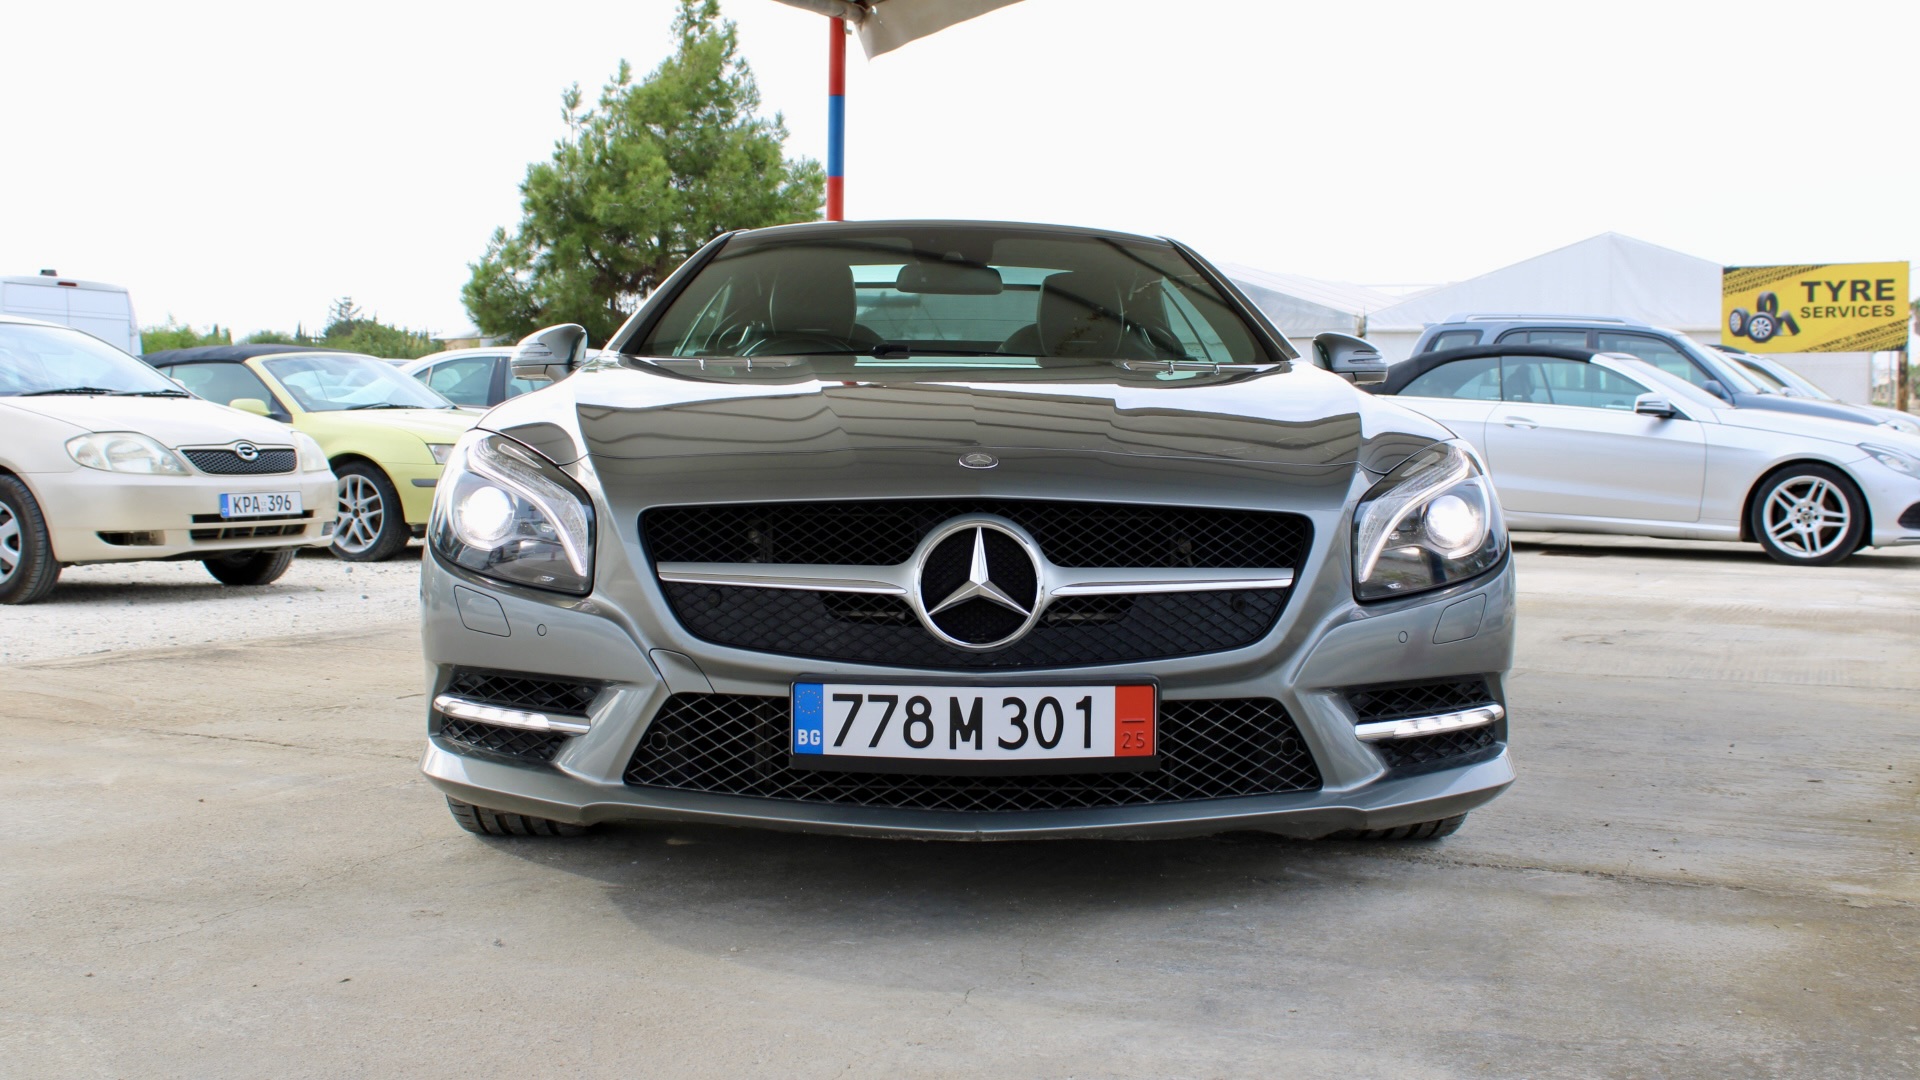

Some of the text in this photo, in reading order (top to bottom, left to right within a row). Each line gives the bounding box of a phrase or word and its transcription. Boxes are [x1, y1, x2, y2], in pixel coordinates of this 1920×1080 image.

[1800, 279, 1896, 303] TYRE
[1800, 305, 1896, 319] SERVICES
[232, 496, 260, 514] KPA
[267, 494, 292, 512] 396
[832, 693, 1092, 750] 778 M 301
[798, 729, 821, 746] BG
[1121, 731, 1146, 749] 25
